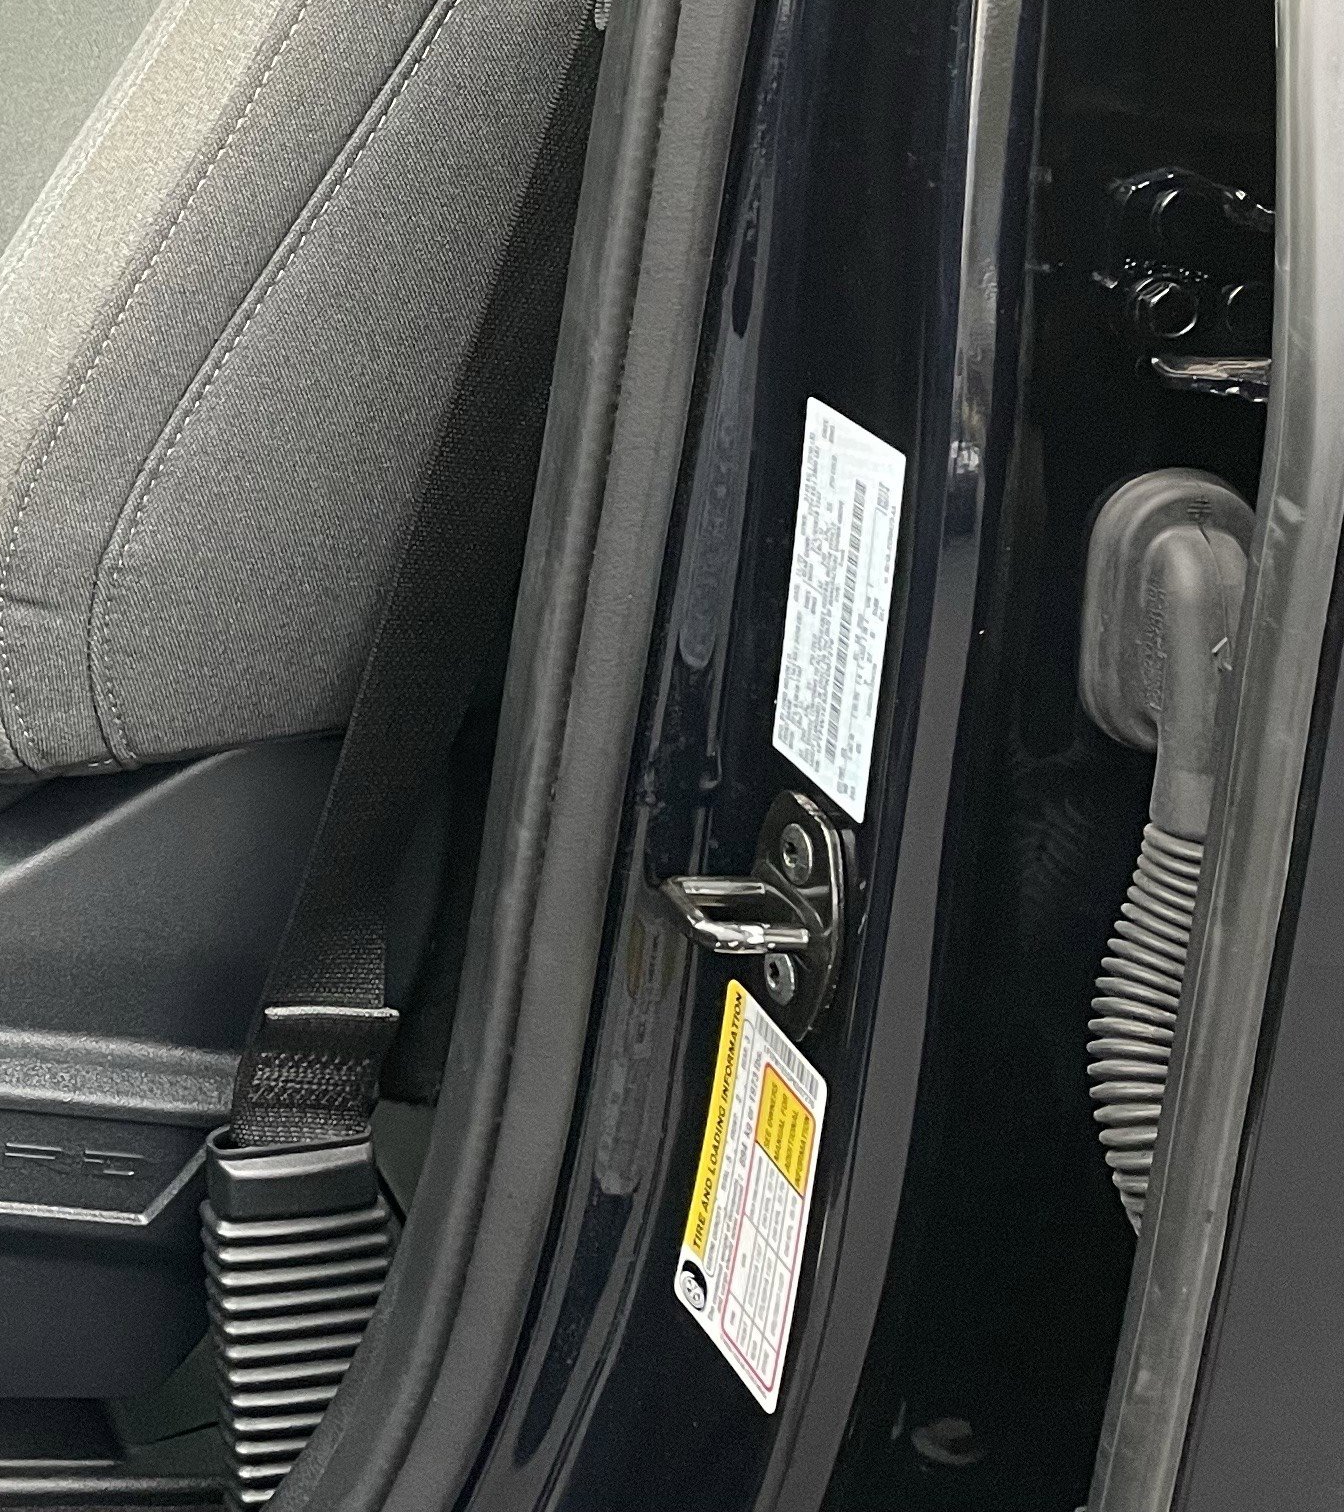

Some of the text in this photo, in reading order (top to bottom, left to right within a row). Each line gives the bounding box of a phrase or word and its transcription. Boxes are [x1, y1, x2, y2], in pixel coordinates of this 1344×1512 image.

[693, 1211, 706, 1250] TIRE
[701, 1177, 713, 1213] AND
[708, 1105, 726, 1176] LOADING
[721, 991, 742, 1103] INFORMATION
